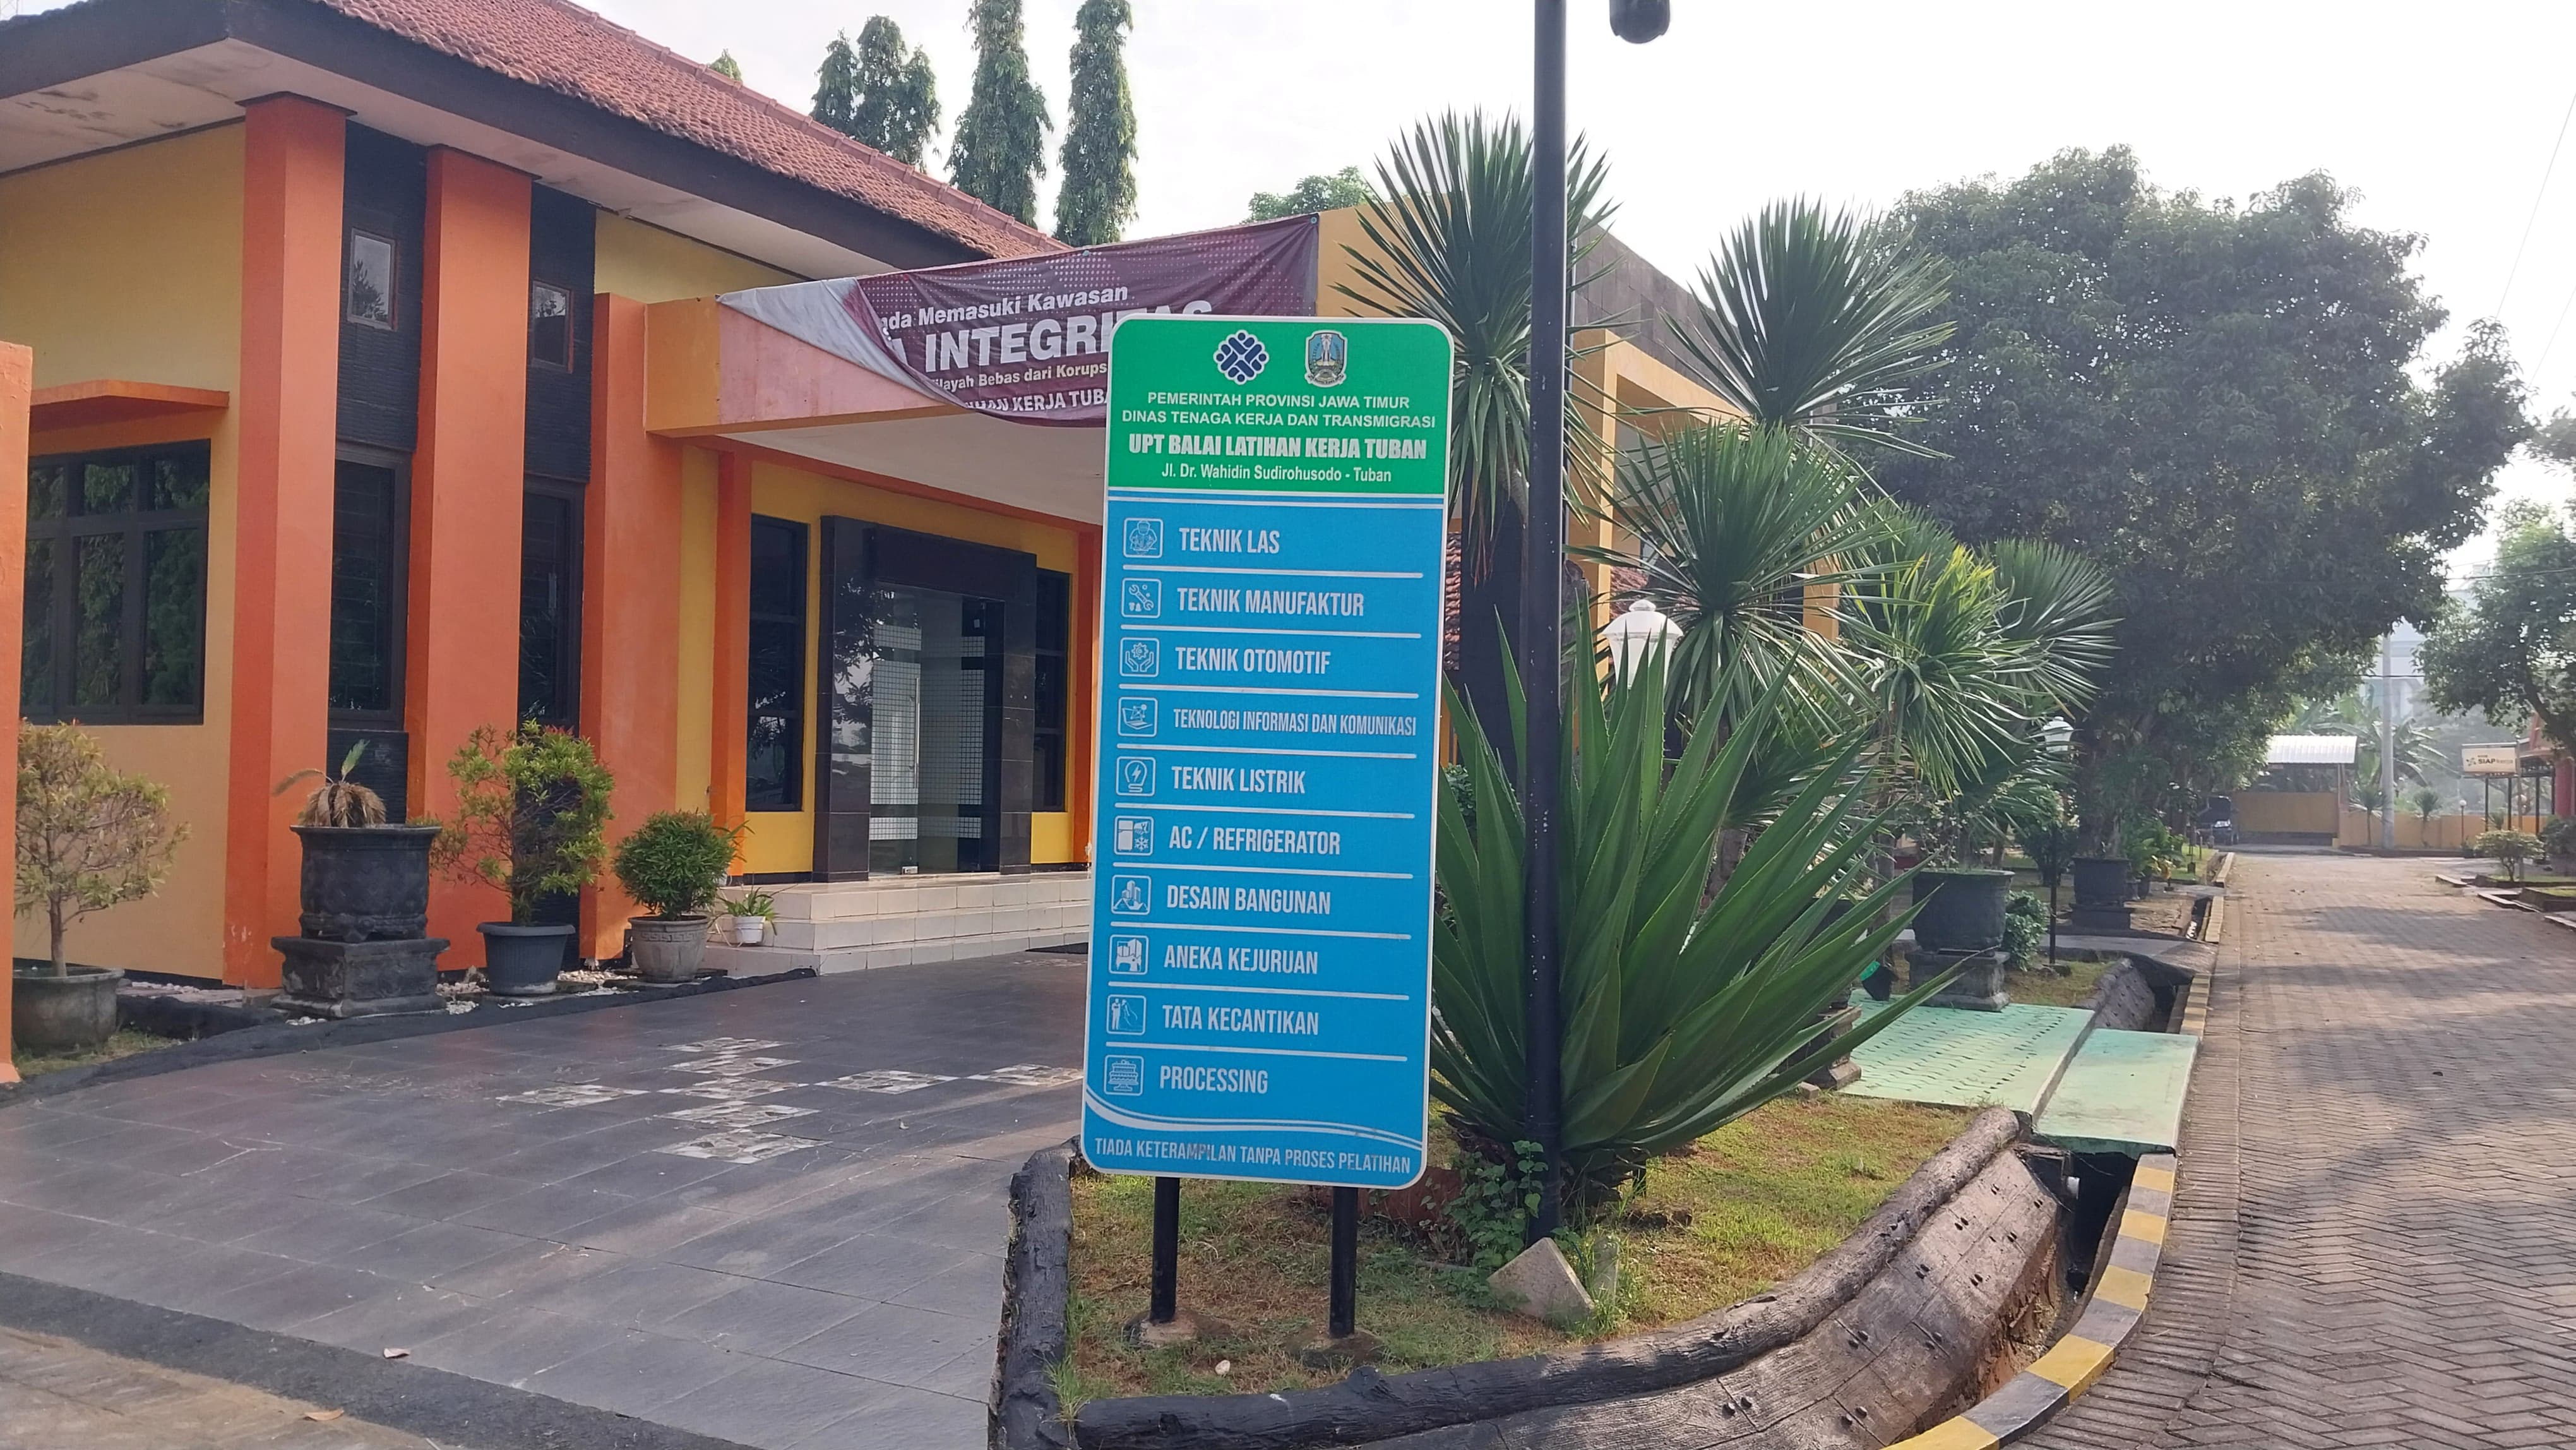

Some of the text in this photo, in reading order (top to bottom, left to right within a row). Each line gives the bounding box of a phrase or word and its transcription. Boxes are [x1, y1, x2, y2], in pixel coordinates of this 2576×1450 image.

[881, 287, 1128, 330] nda Memasuki Kawasan
[926, 300, 1212, 373] INTEGRI
[979, 372, 1020, 387] Bebas
[1024, 366, 1052, 381] dari
[1056, 362, 1107, 378] Korups
[1012, 392, 1066, 412] KERJA
[1069, 388, 1108, 407] TUB
[1148, 392, 1410, 409] PEMERINTAH PROVINSI JAWA TIMUR
[1122, 410, 1435, 428] DINAS TENAGA KERJA DAN TRANSMIGRASI
[1129, 433, 1427, 459] UPT BALAI LATIHAN KERJA TUBAN
[1161, 462, 1176, 477] Jl.
[1180, 463, 1197, 478] Dr.
[1200, 464, 1251, 479] Wahidin
[1253, 465, 1342, 481] Sudirohusodo
[1353, 467, 1392, 482] Tuban
[1179, 527, 1280, 554] TEKNIK LAS
[1177, 587, 1364, 616] TEKNIK MANUFAKTUR
[1175, 647, 1331, 674] TEKNIK OTOMOTIF
[1173, 708, 1416, 736] TEKNOLOGI INFORMASI DAN KOMUNIKASI
[1171, 766, 1306, 794] TEKNIK LISTRIK
[1169, 825, 1340, 855] AC / REFRIGERATOR
[1167, 885, 1331, 915] DESAIN BANGUNAN
[1164, 945, 1318, 974] ANEKA KEJURUAN
[1162, 1005, 1319, 1036] TATA KECANTIKAN
[1160, 1065, 1268, 1094] PROCESSING
[1095, 1137, 1410, 1174] TIADA KETERAMPILAN TANPA PROSES PELATIHAN
